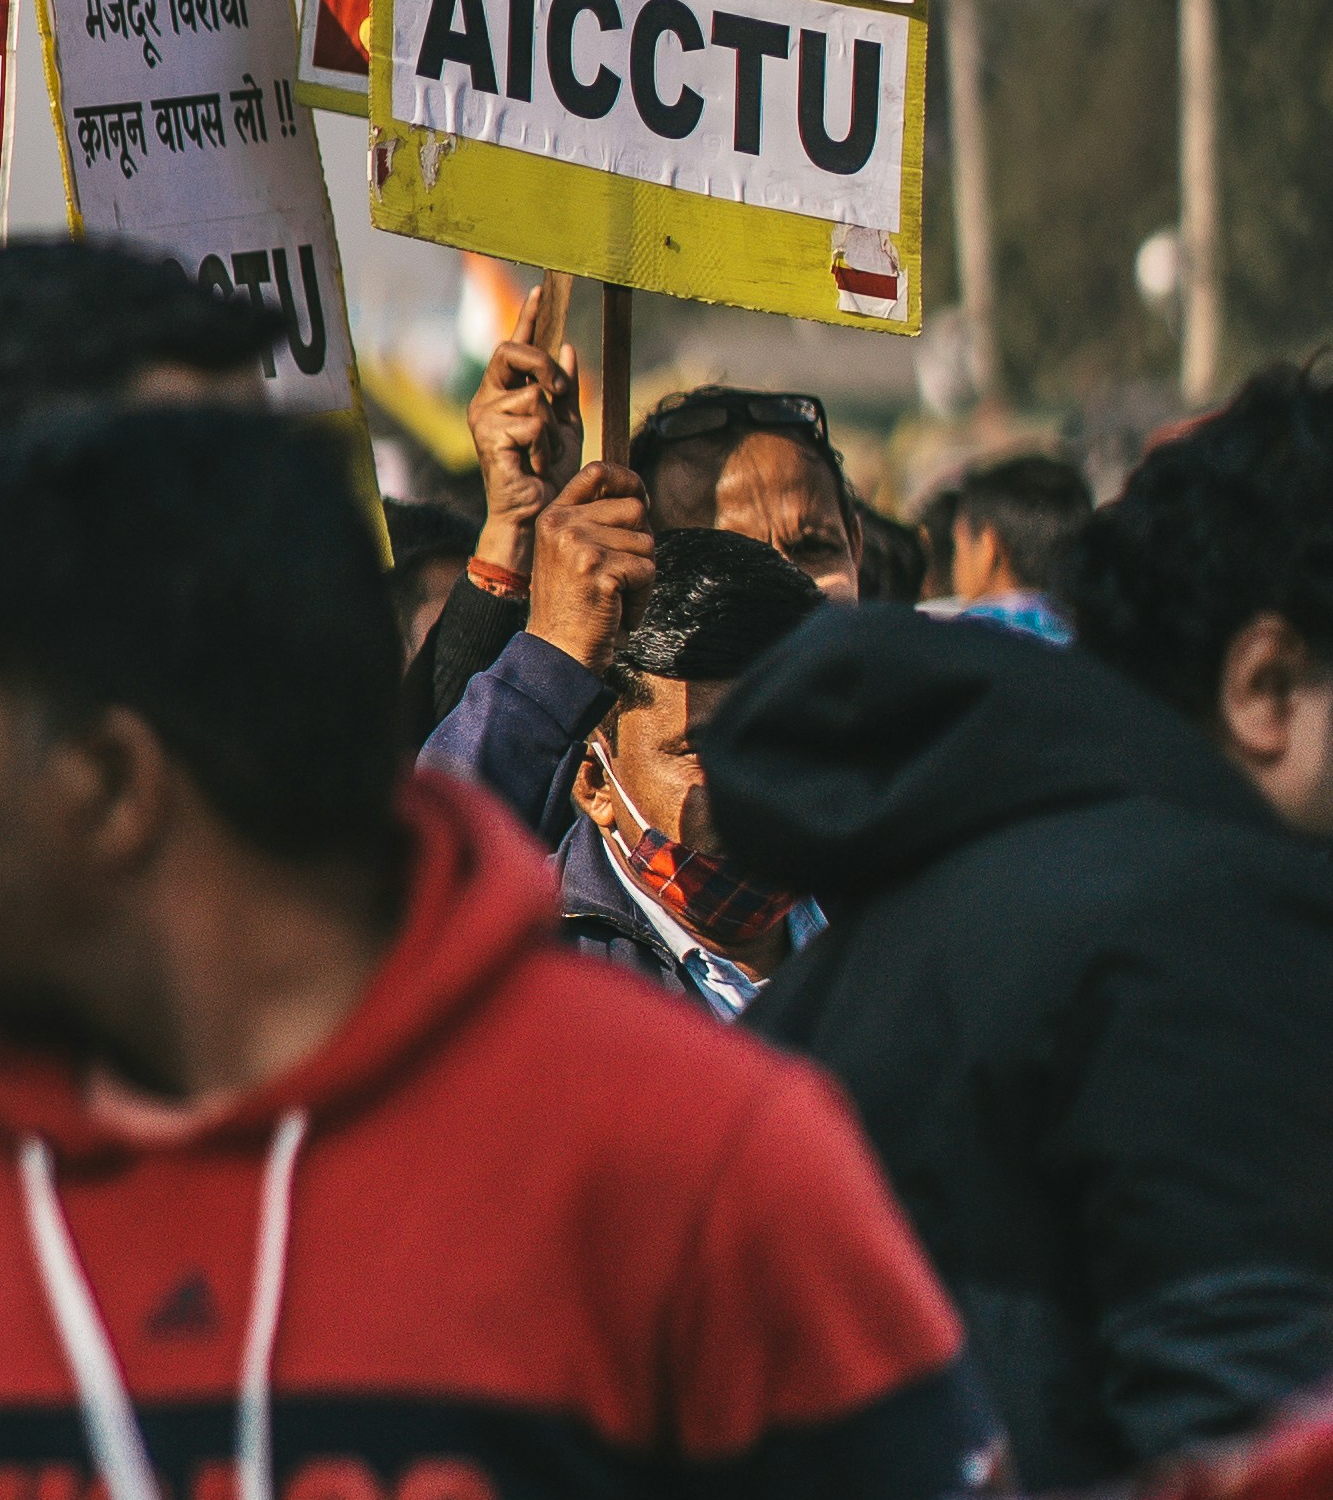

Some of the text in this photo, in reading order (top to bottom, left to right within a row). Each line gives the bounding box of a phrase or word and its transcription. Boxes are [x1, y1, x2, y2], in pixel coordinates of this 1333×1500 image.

[151, 91, 225, 157] वापस
[232, 73, 269, 146] लो
[273, 79, 296, 138] !!
